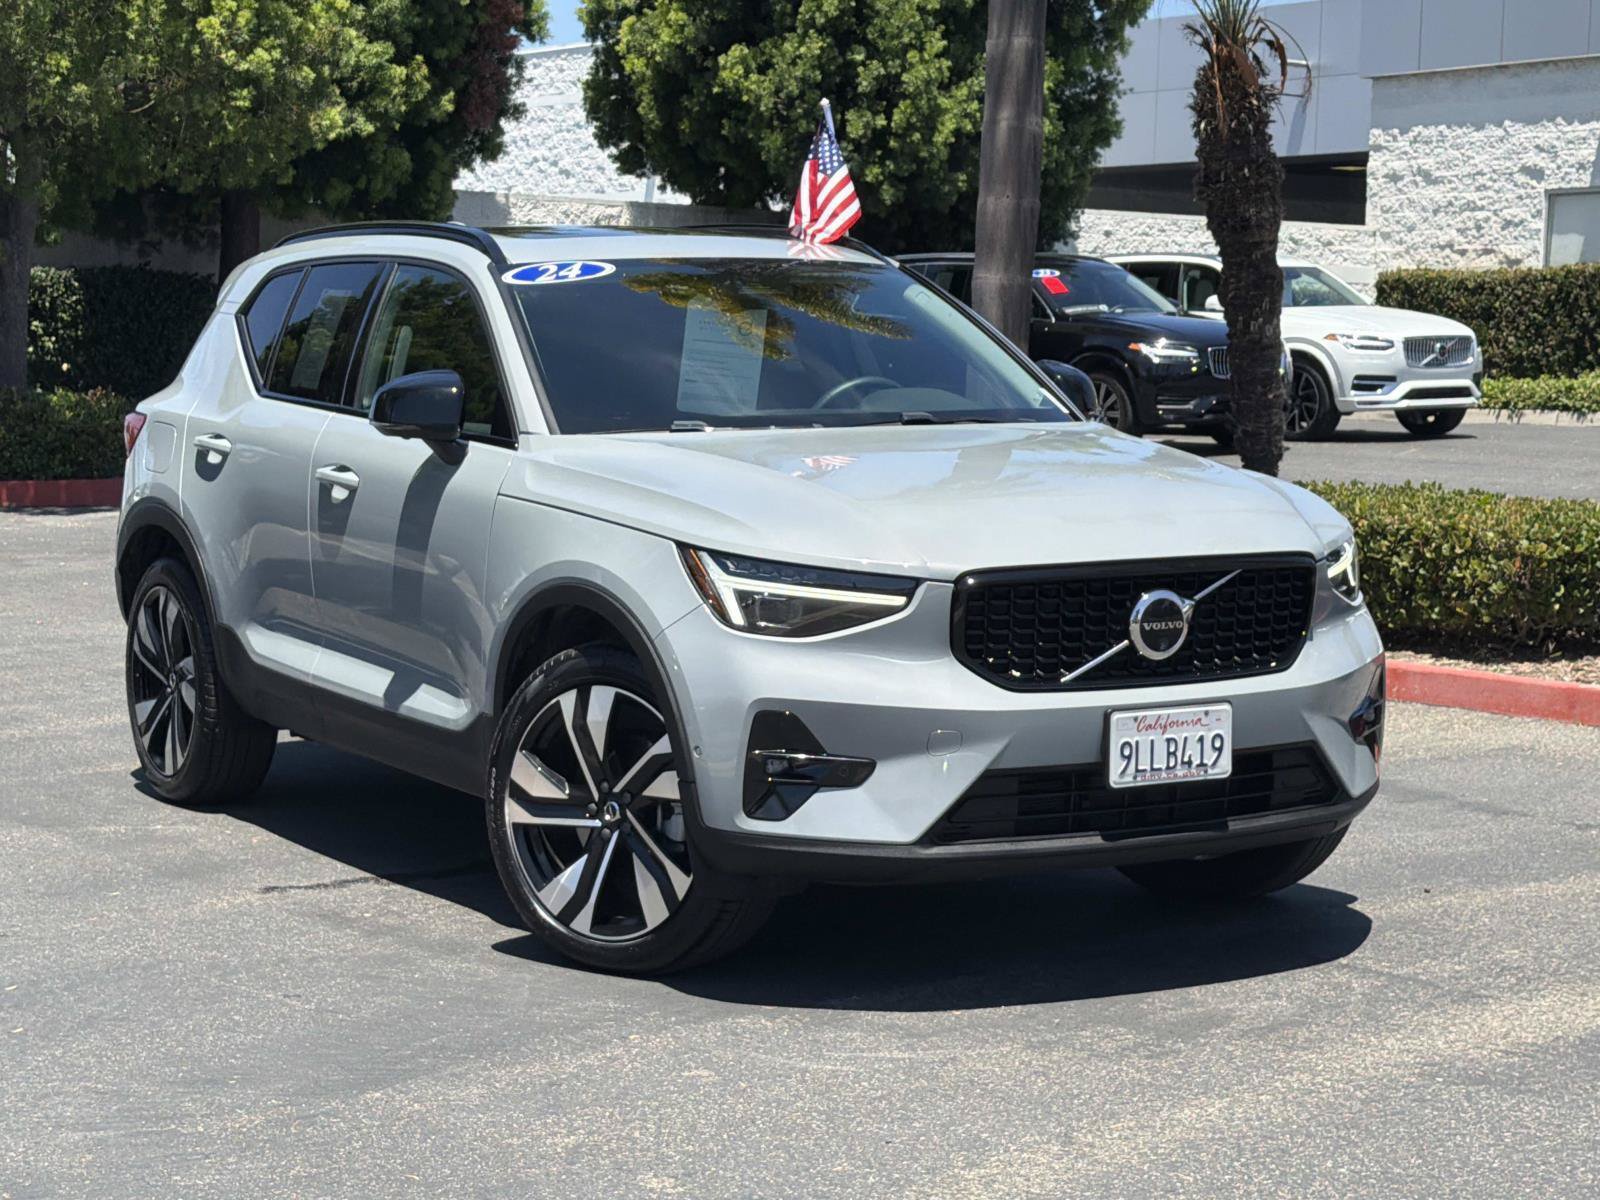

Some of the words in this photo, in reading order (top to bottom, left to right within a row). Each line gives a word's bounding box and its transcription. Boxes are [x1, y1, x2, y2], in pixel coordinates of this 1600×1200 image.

[537, 262, 583, 282] 24
[1143, 620, 1183, 630] VOLVO
[1136, 713, 1210, 735] California
[1119, 733, 1224, 778] 9LLB419
